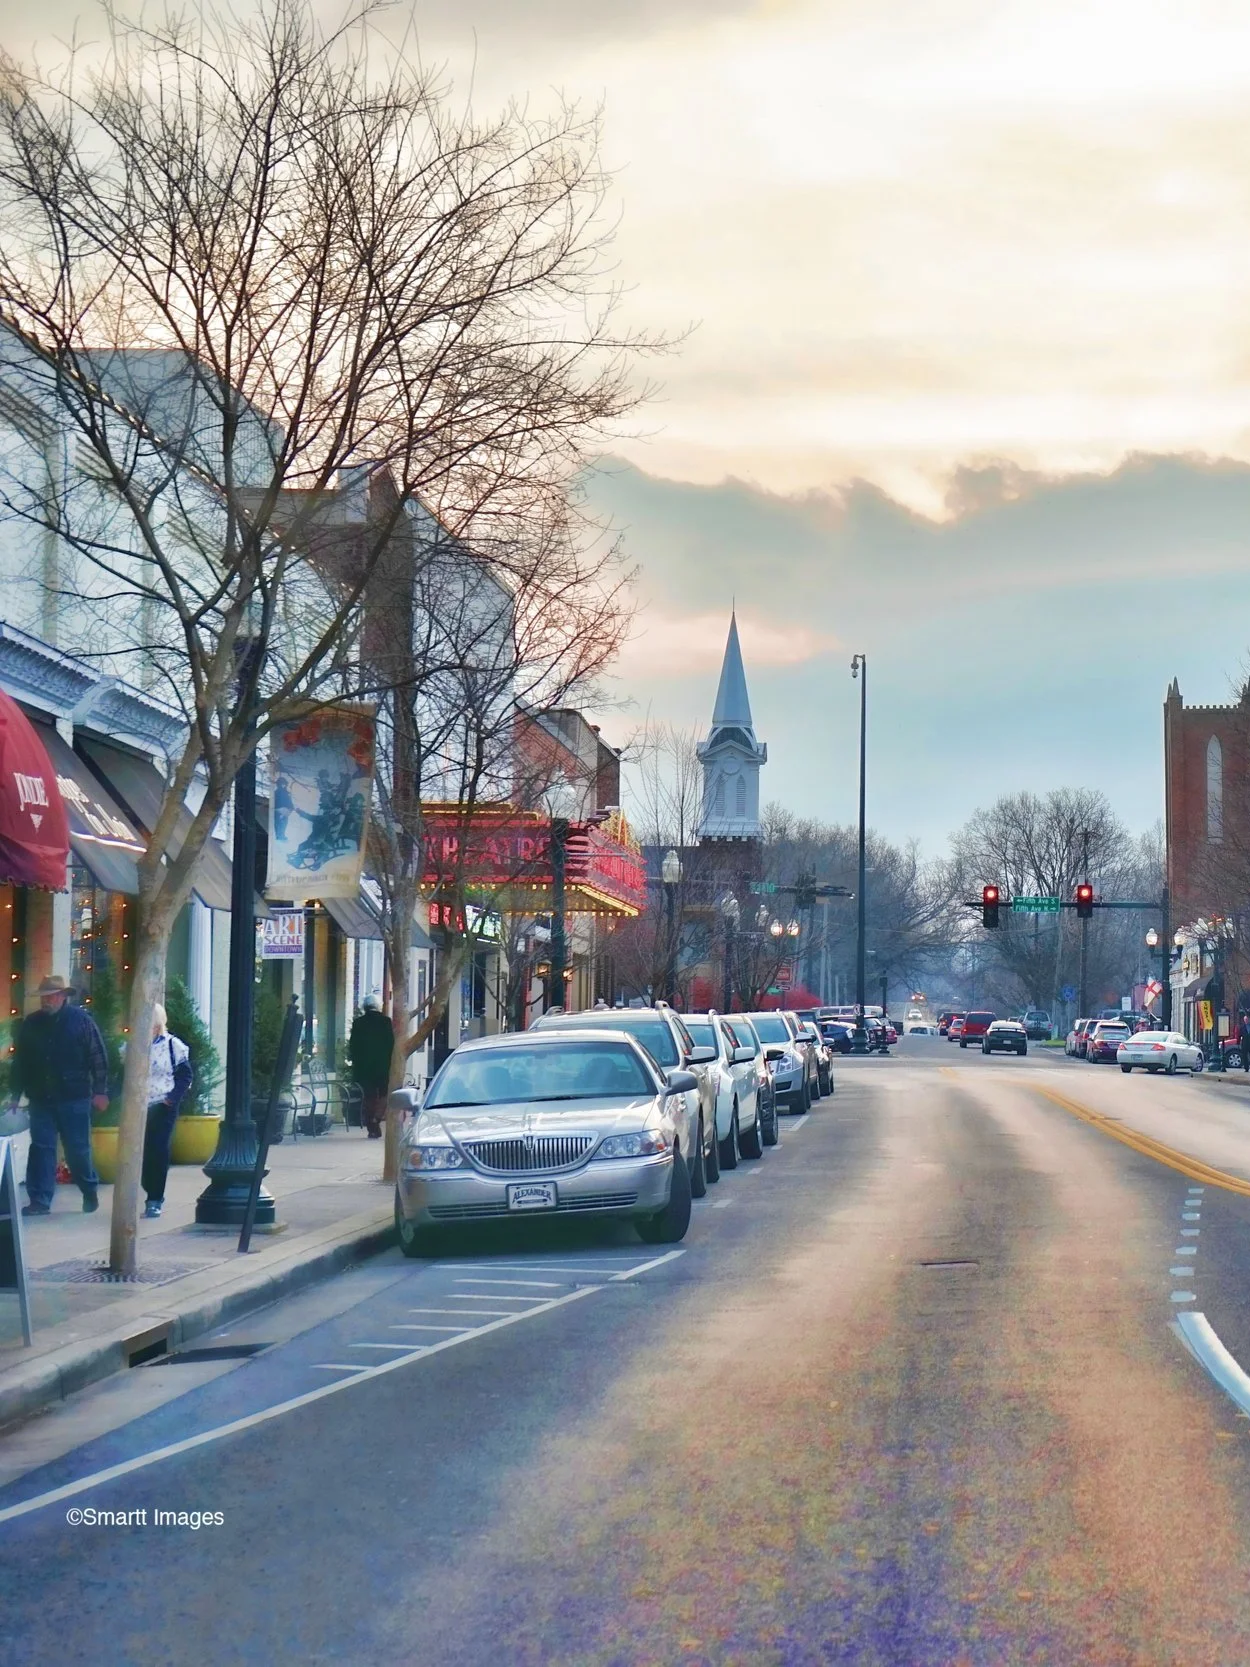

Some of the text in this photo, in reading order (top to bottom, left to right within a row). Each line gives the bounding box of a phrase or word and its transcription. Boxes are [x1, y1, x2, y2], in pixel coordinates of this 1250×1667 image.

[262, 914, 303, 935] ART
[264, 936, 303, 945] SCENE
[512, 1187, 552, 1204] ALEXANDER
